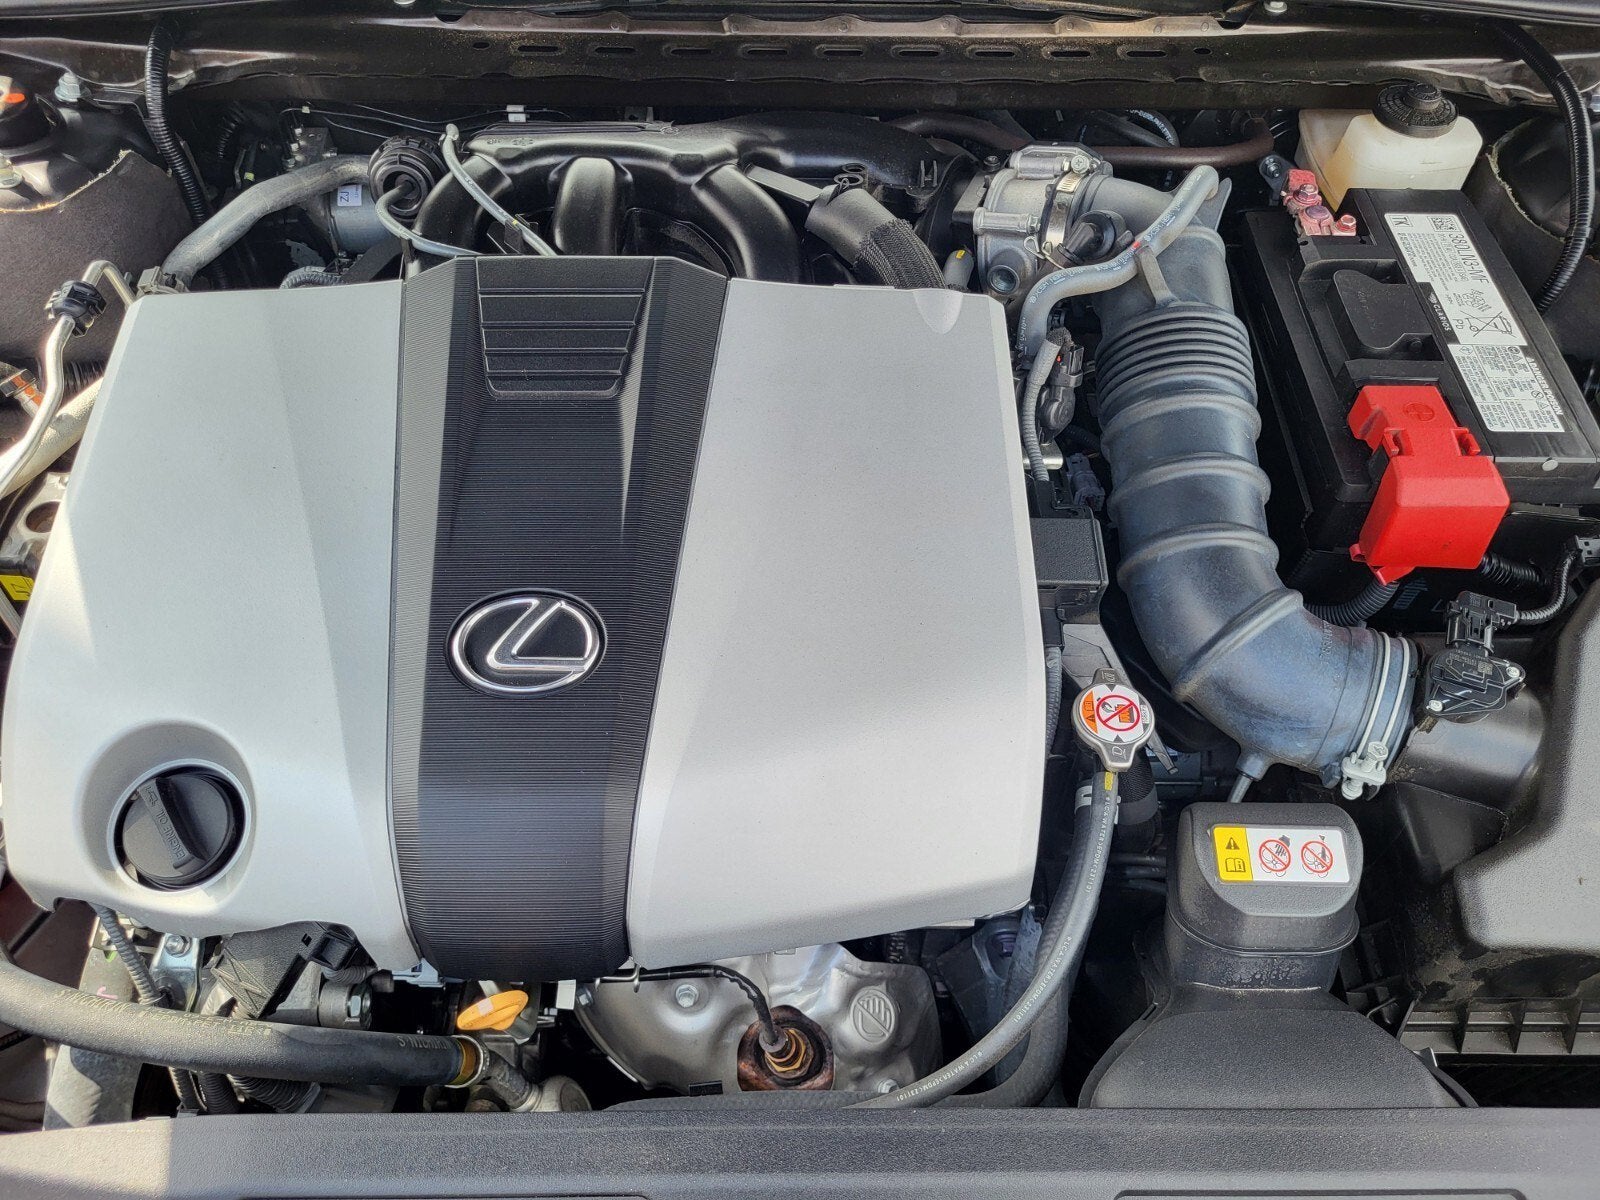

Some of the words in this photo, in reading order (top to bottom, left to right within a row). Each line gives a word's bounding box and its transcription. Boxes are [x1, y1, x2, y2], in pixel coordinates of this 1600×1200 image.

[1389, 216, 1411, 226] TK
[1446, 233, 1490, 283] 380LN3-MF
[1450, 318, 1468, 329] Pb
[156, 808, 169, 825] OIL
[163, 826, 186, 860] ENGINE
